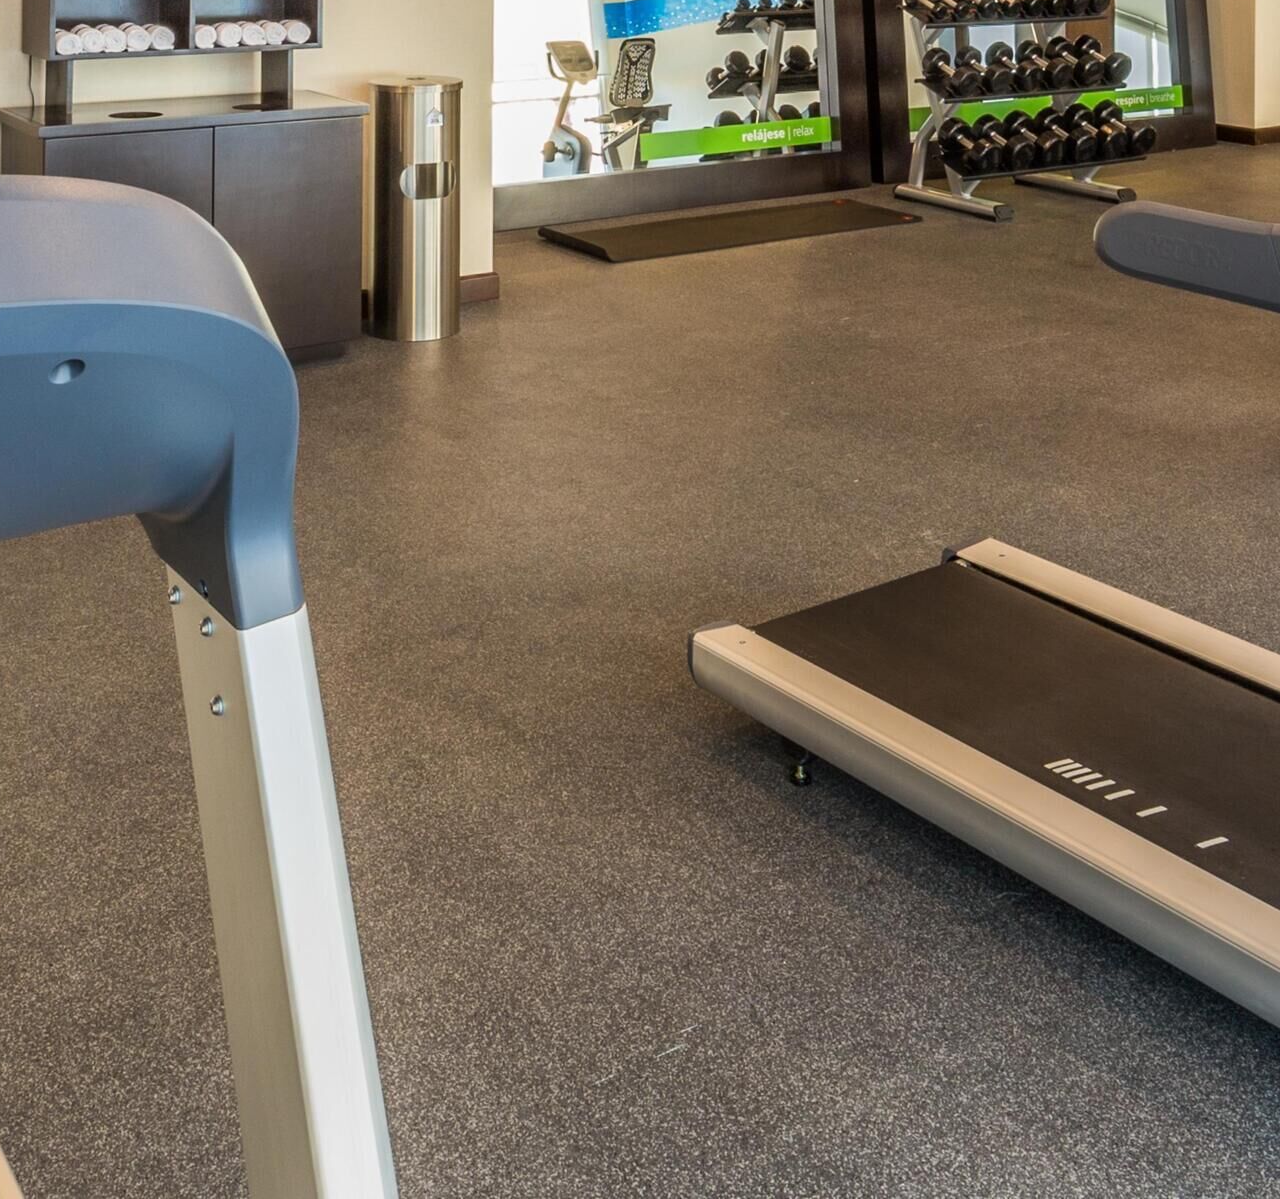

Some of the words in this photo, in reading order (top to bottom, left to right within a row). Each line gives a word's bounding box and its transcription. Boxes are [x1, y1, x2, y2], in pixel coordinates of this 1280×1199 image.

[1115, 94, 1145, 106] respire
[1149, 92, 1176, 102] breathe
[741, 128, 786, 143] relájese
[793, 125, 815, 137] relax
